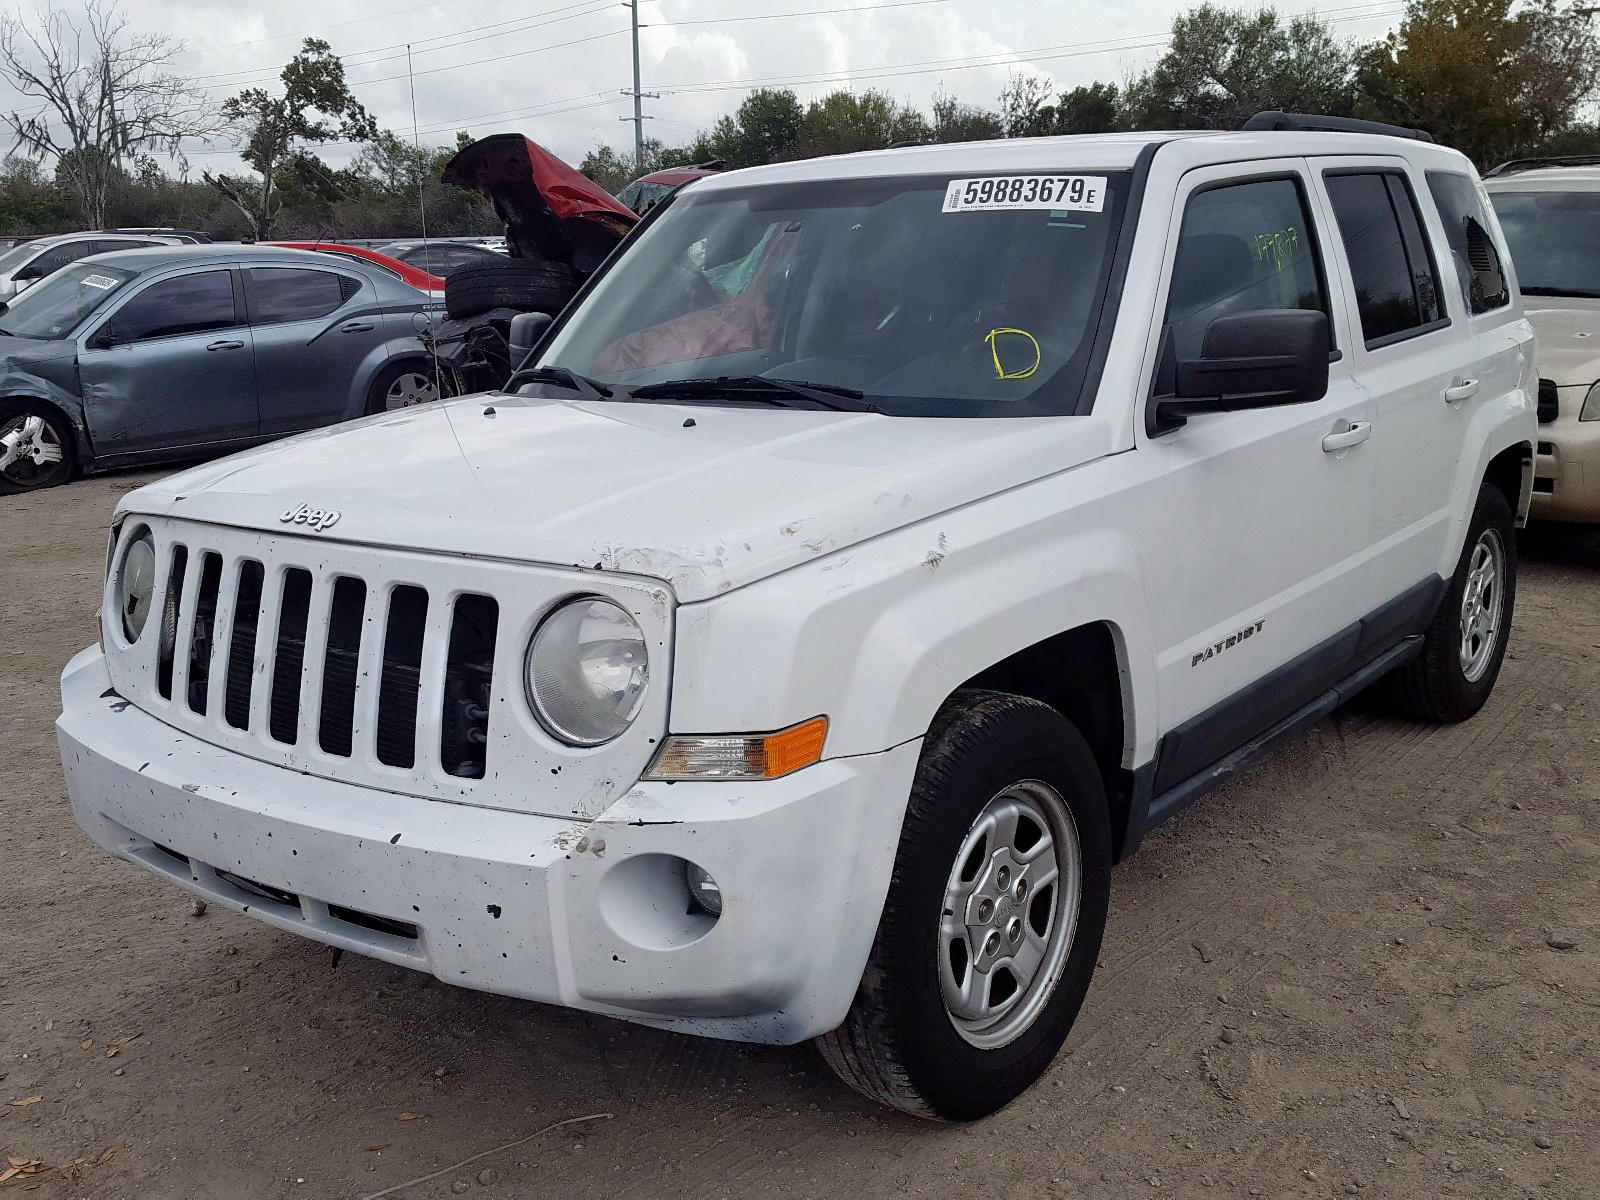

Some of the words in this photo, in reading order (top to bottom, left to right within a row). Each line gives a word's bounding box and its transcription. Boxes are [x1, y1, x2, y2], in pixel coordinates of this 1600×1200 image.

[964, 178, 1085, 204] 59883679
[985, 328, 1040, 380] D
[280, 501, 341, 532] Jeep
[1191, 619, 1265, 667] PATRIOT
